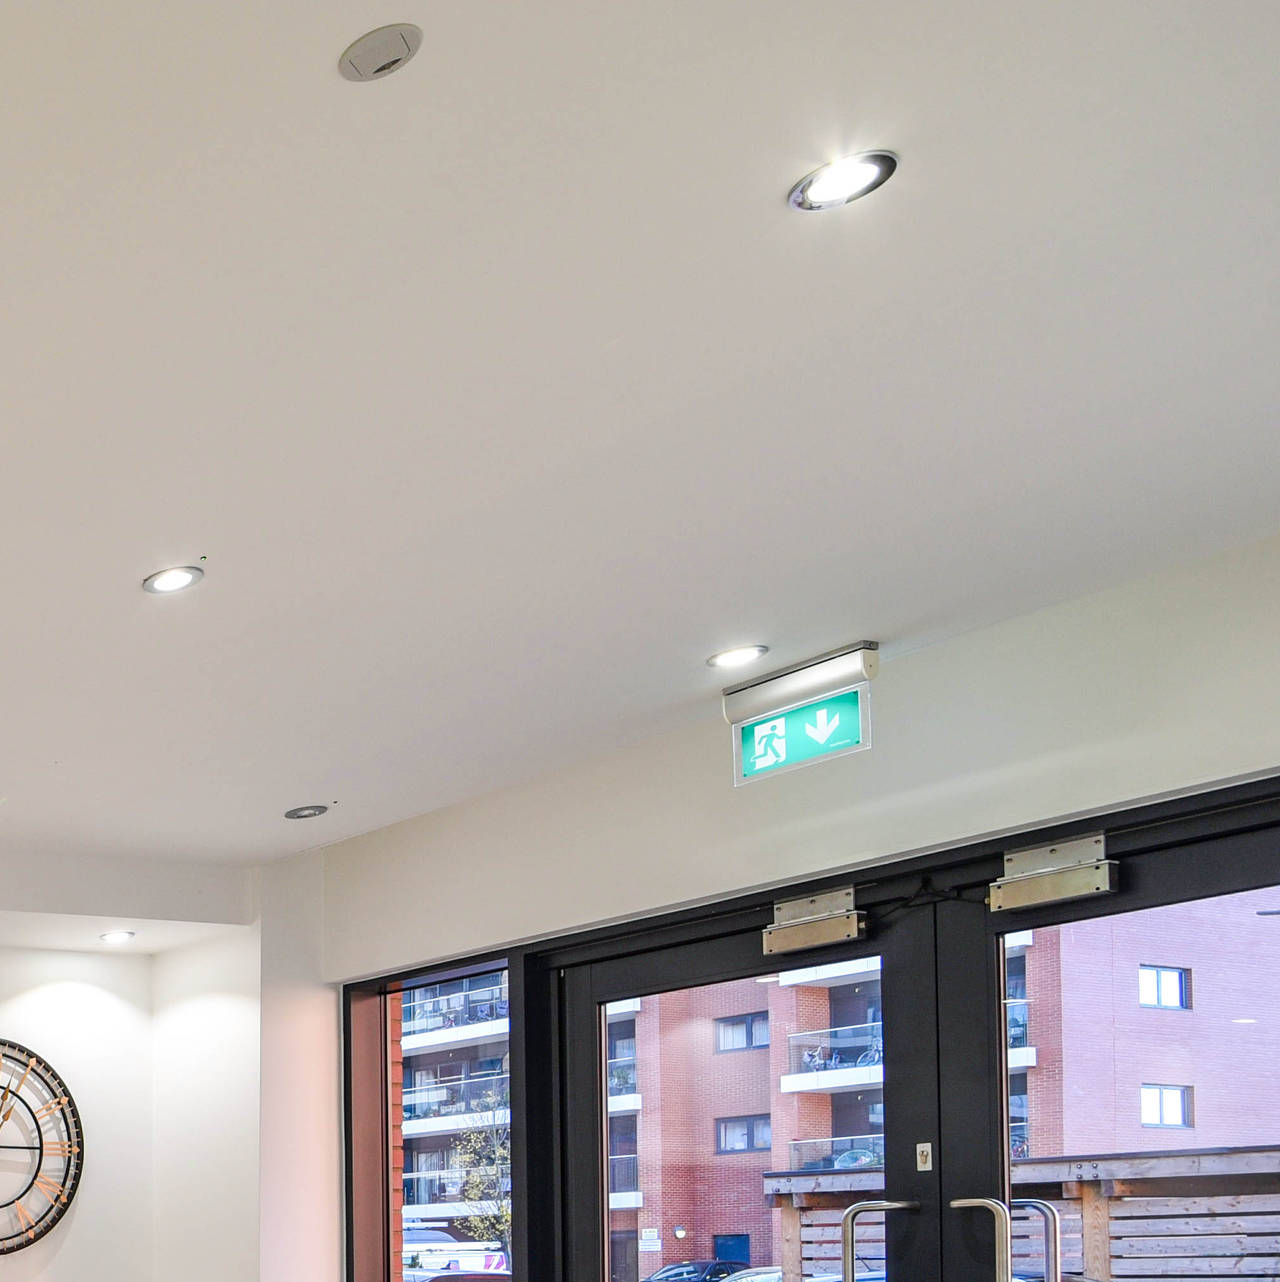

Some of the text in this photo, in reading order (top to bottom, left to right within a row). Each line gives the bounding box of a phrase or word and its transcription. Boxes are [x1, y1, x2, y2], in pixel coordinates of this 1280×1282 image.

[34, 1097, 63, 1121] II
[43, 1141, 72, 1156] III
[34, 1172, 64, 1205] IV
[14, 1200, 36, 1232] V
